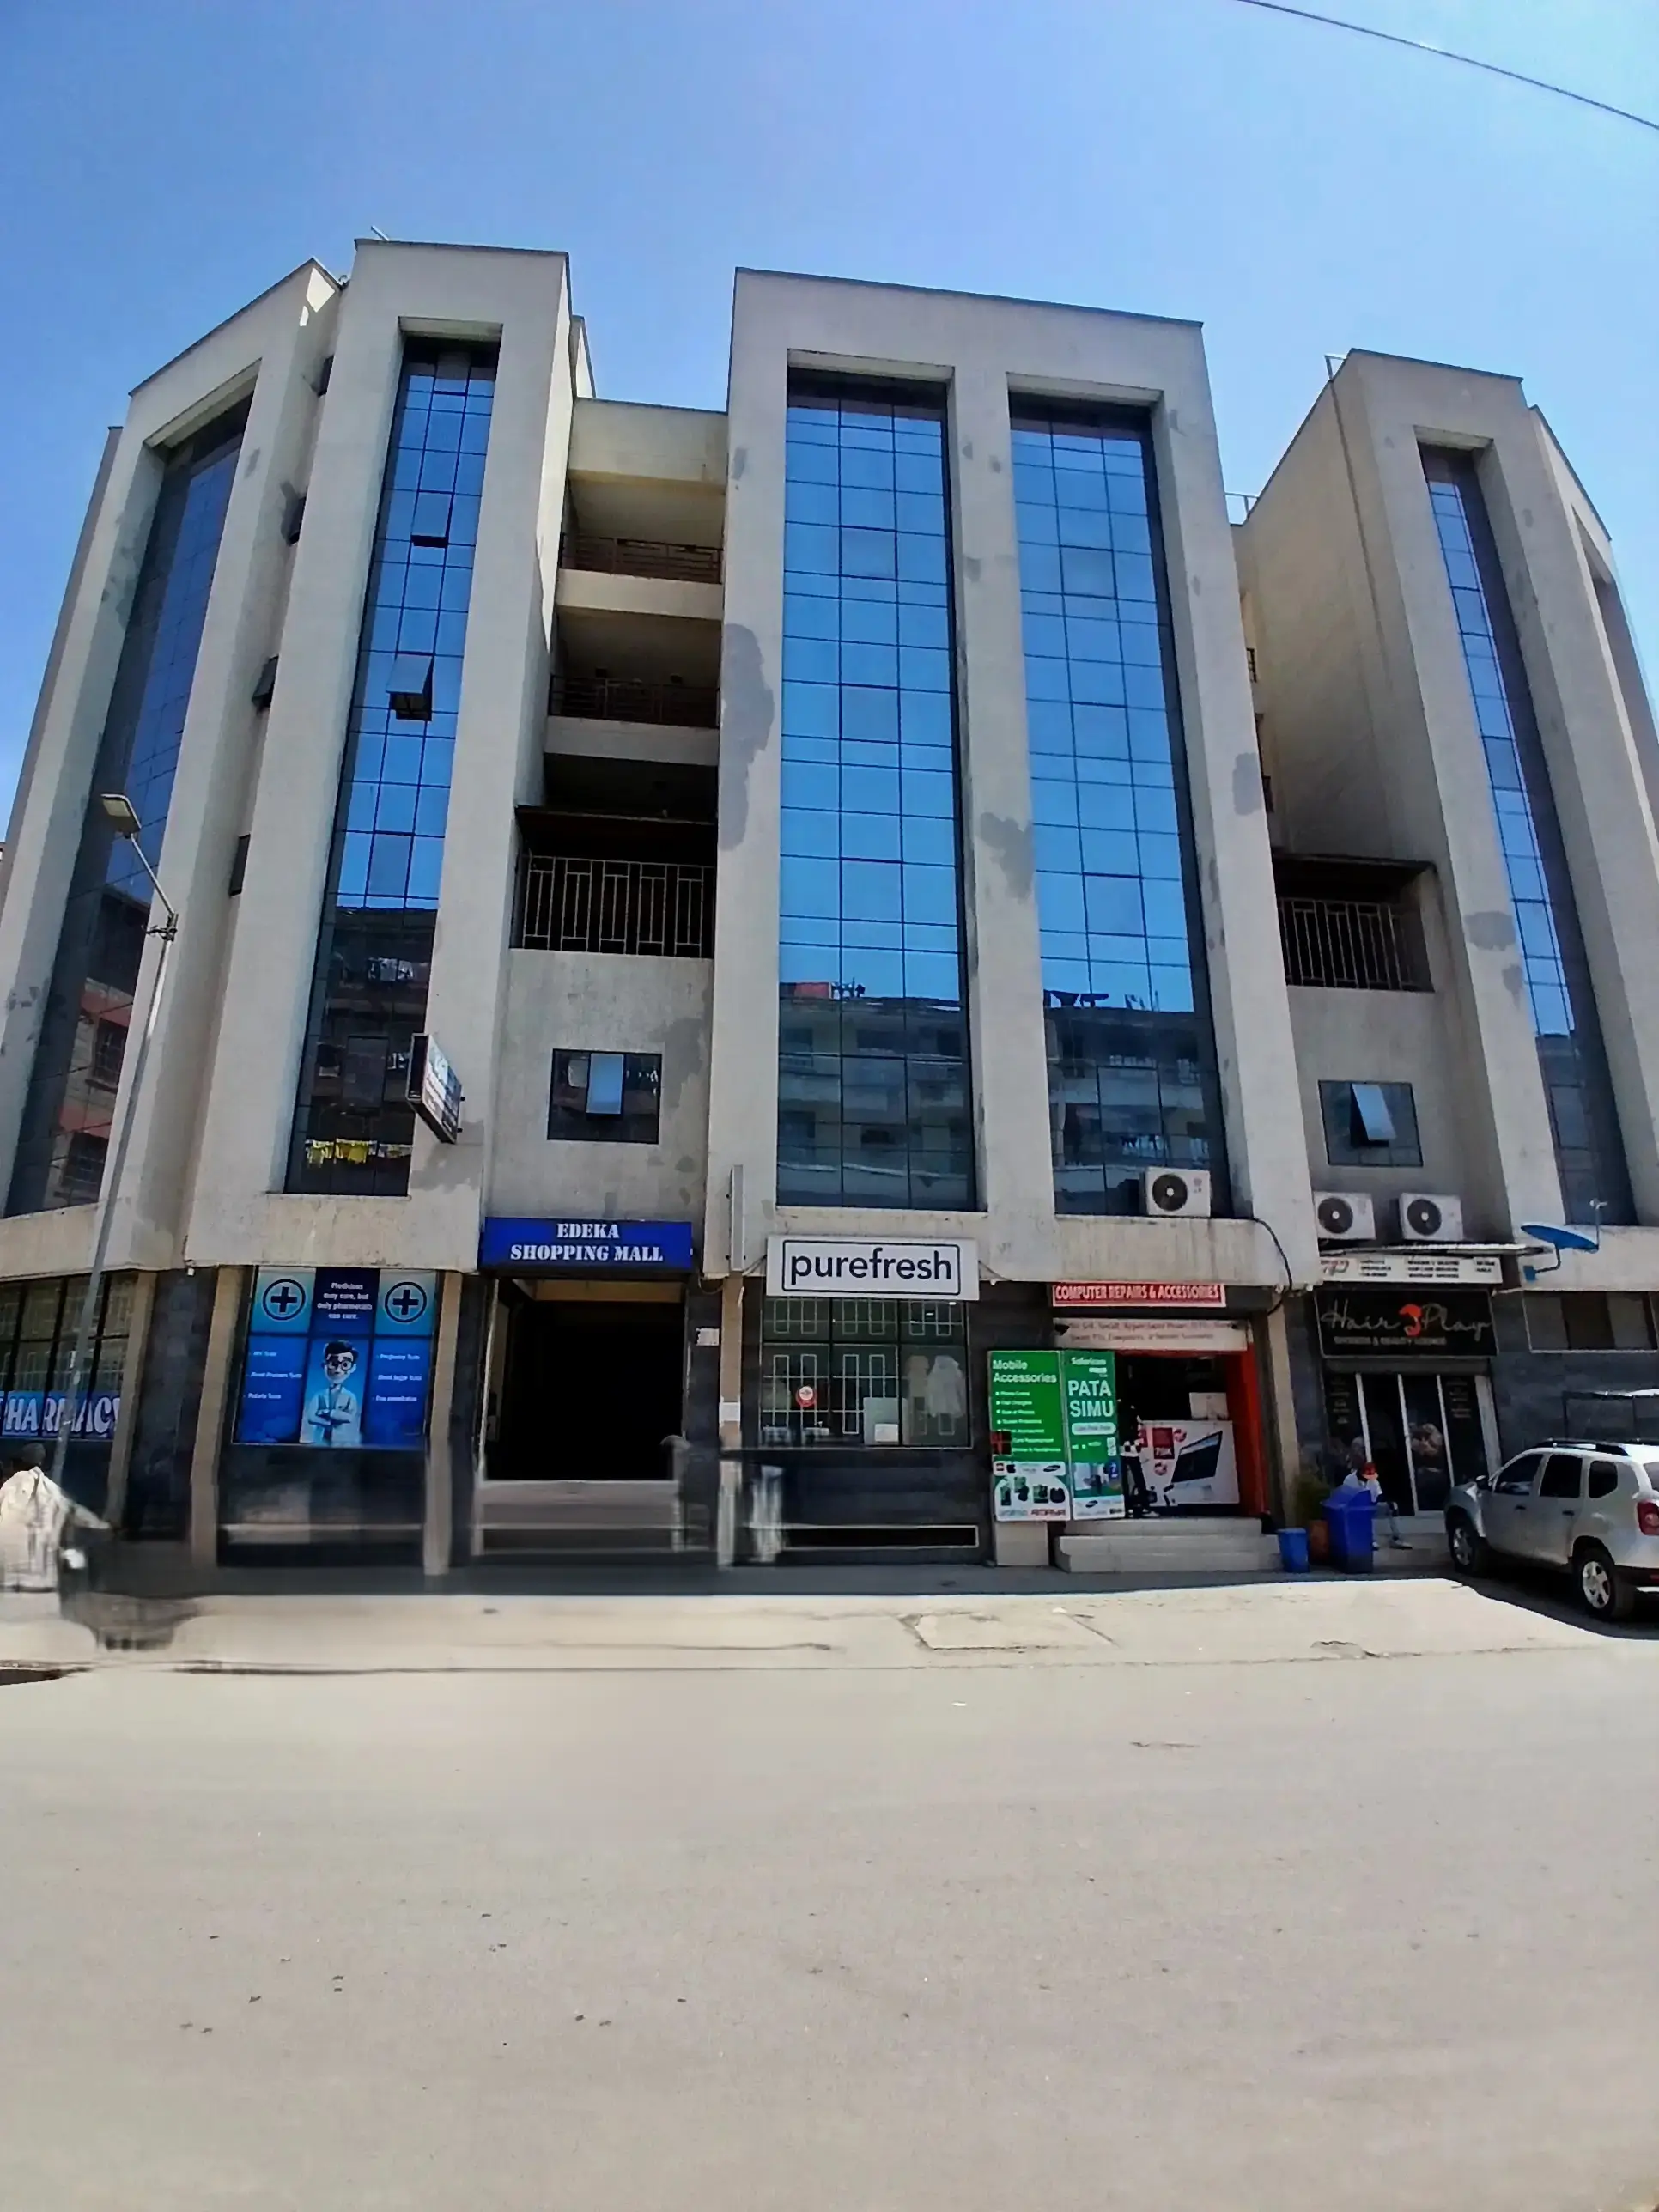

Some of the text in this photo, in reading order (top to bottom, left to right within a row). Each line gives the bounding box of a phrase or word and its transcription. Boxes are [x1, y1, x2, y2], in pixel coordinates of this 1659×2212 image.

[556, 1223, 620, 1239] EDEKA
[510, 1244, 663, 1261] SHOPPING MALL
[790, 1247, 952, 1285] purefresh
[1055, 1285, 1107, 1300] COMPUTER
[1149, 1286, 1156, 1299] &
[1158, 1285, 1219, 1300] ACCESSORIES
[1321, 1298, 1492, 1342] Hair Play
[993, 1359, 1028, 1370] Mobile
[994, 1372, 1058, 1383] Accessories
[1067, 1379, 1112, 1397] PATA
[1069, 1400, 1115, 1418] SIMU
